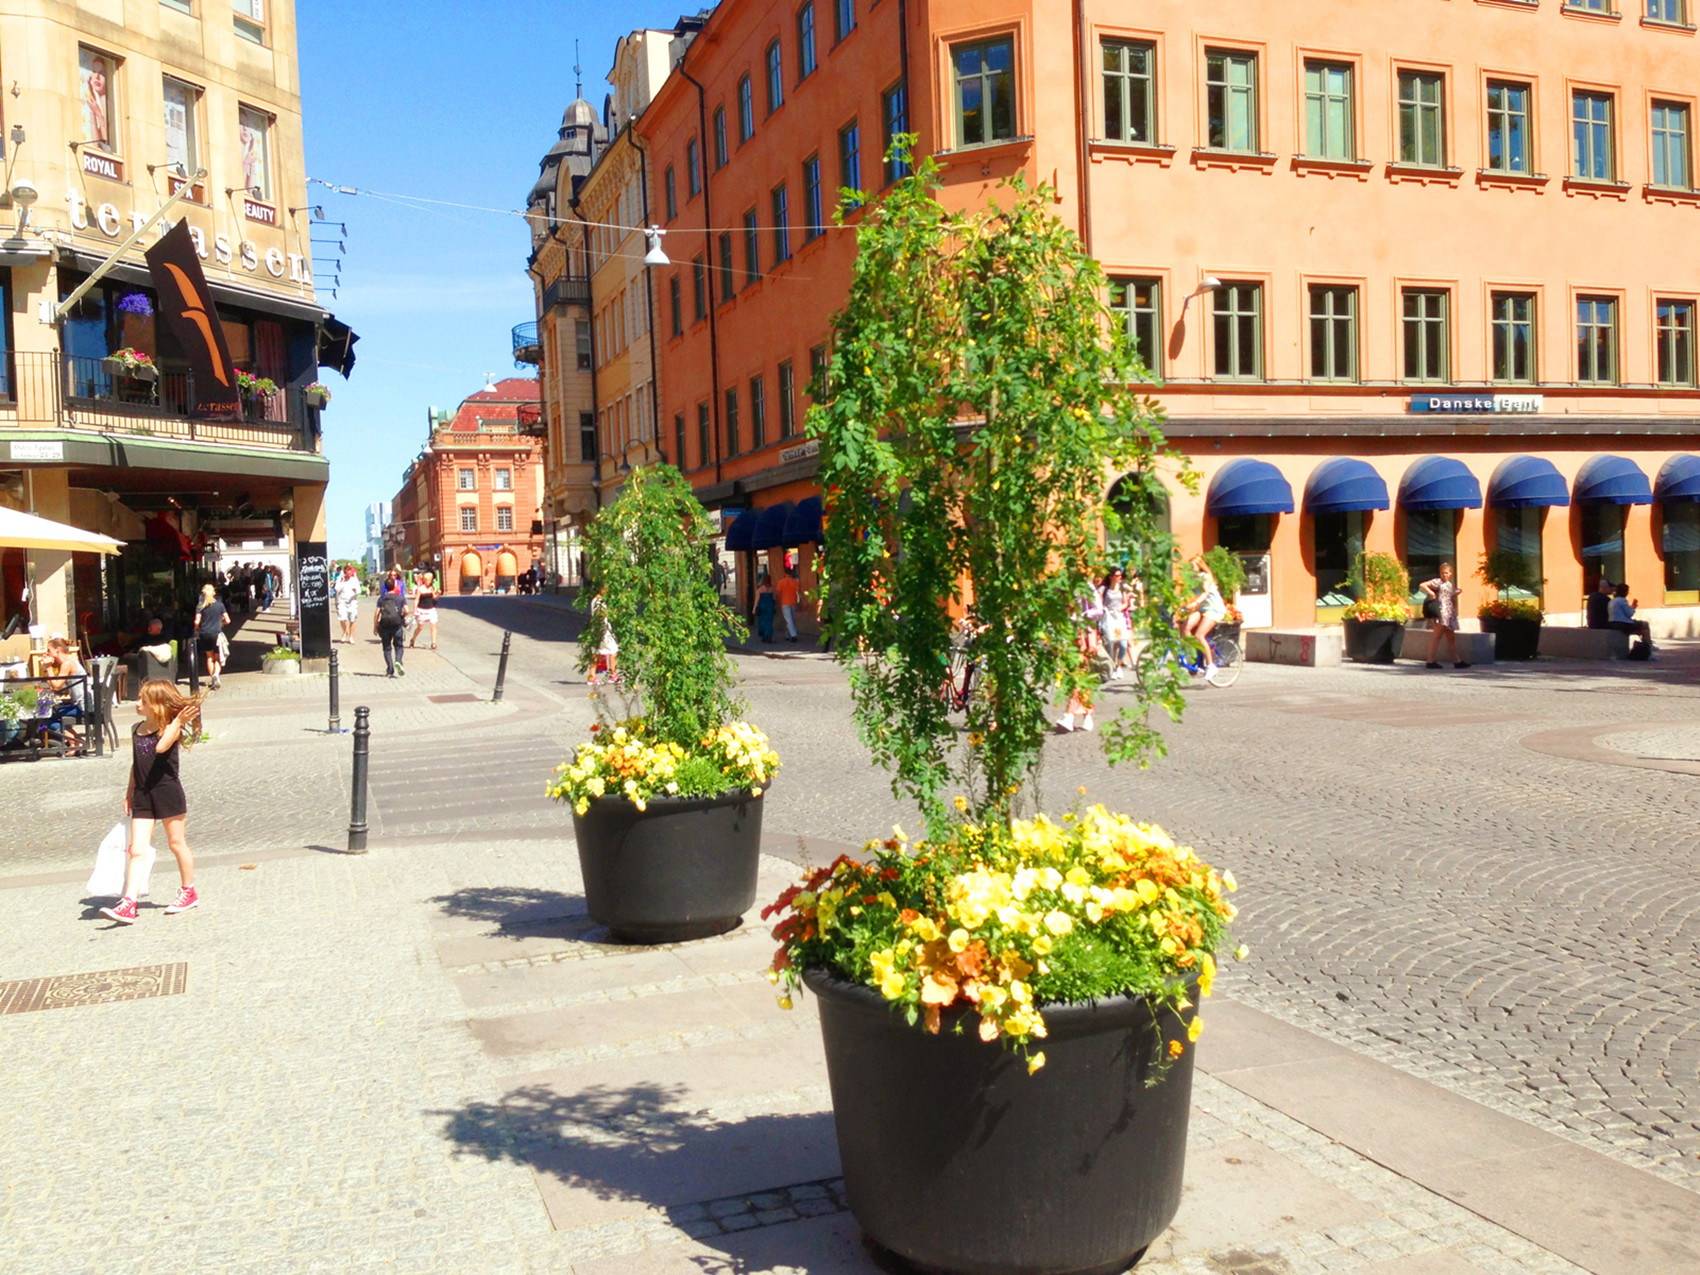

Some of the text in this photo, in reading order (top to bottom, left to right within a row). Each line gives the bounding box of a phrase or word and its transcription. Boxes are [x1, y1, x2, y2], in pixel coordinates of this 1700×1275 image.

[83, 154, 118, 178] ROYAL
[245, 202, 274, 223] EAUTY
[1429, 397, 1541, 409] Danske Bank
